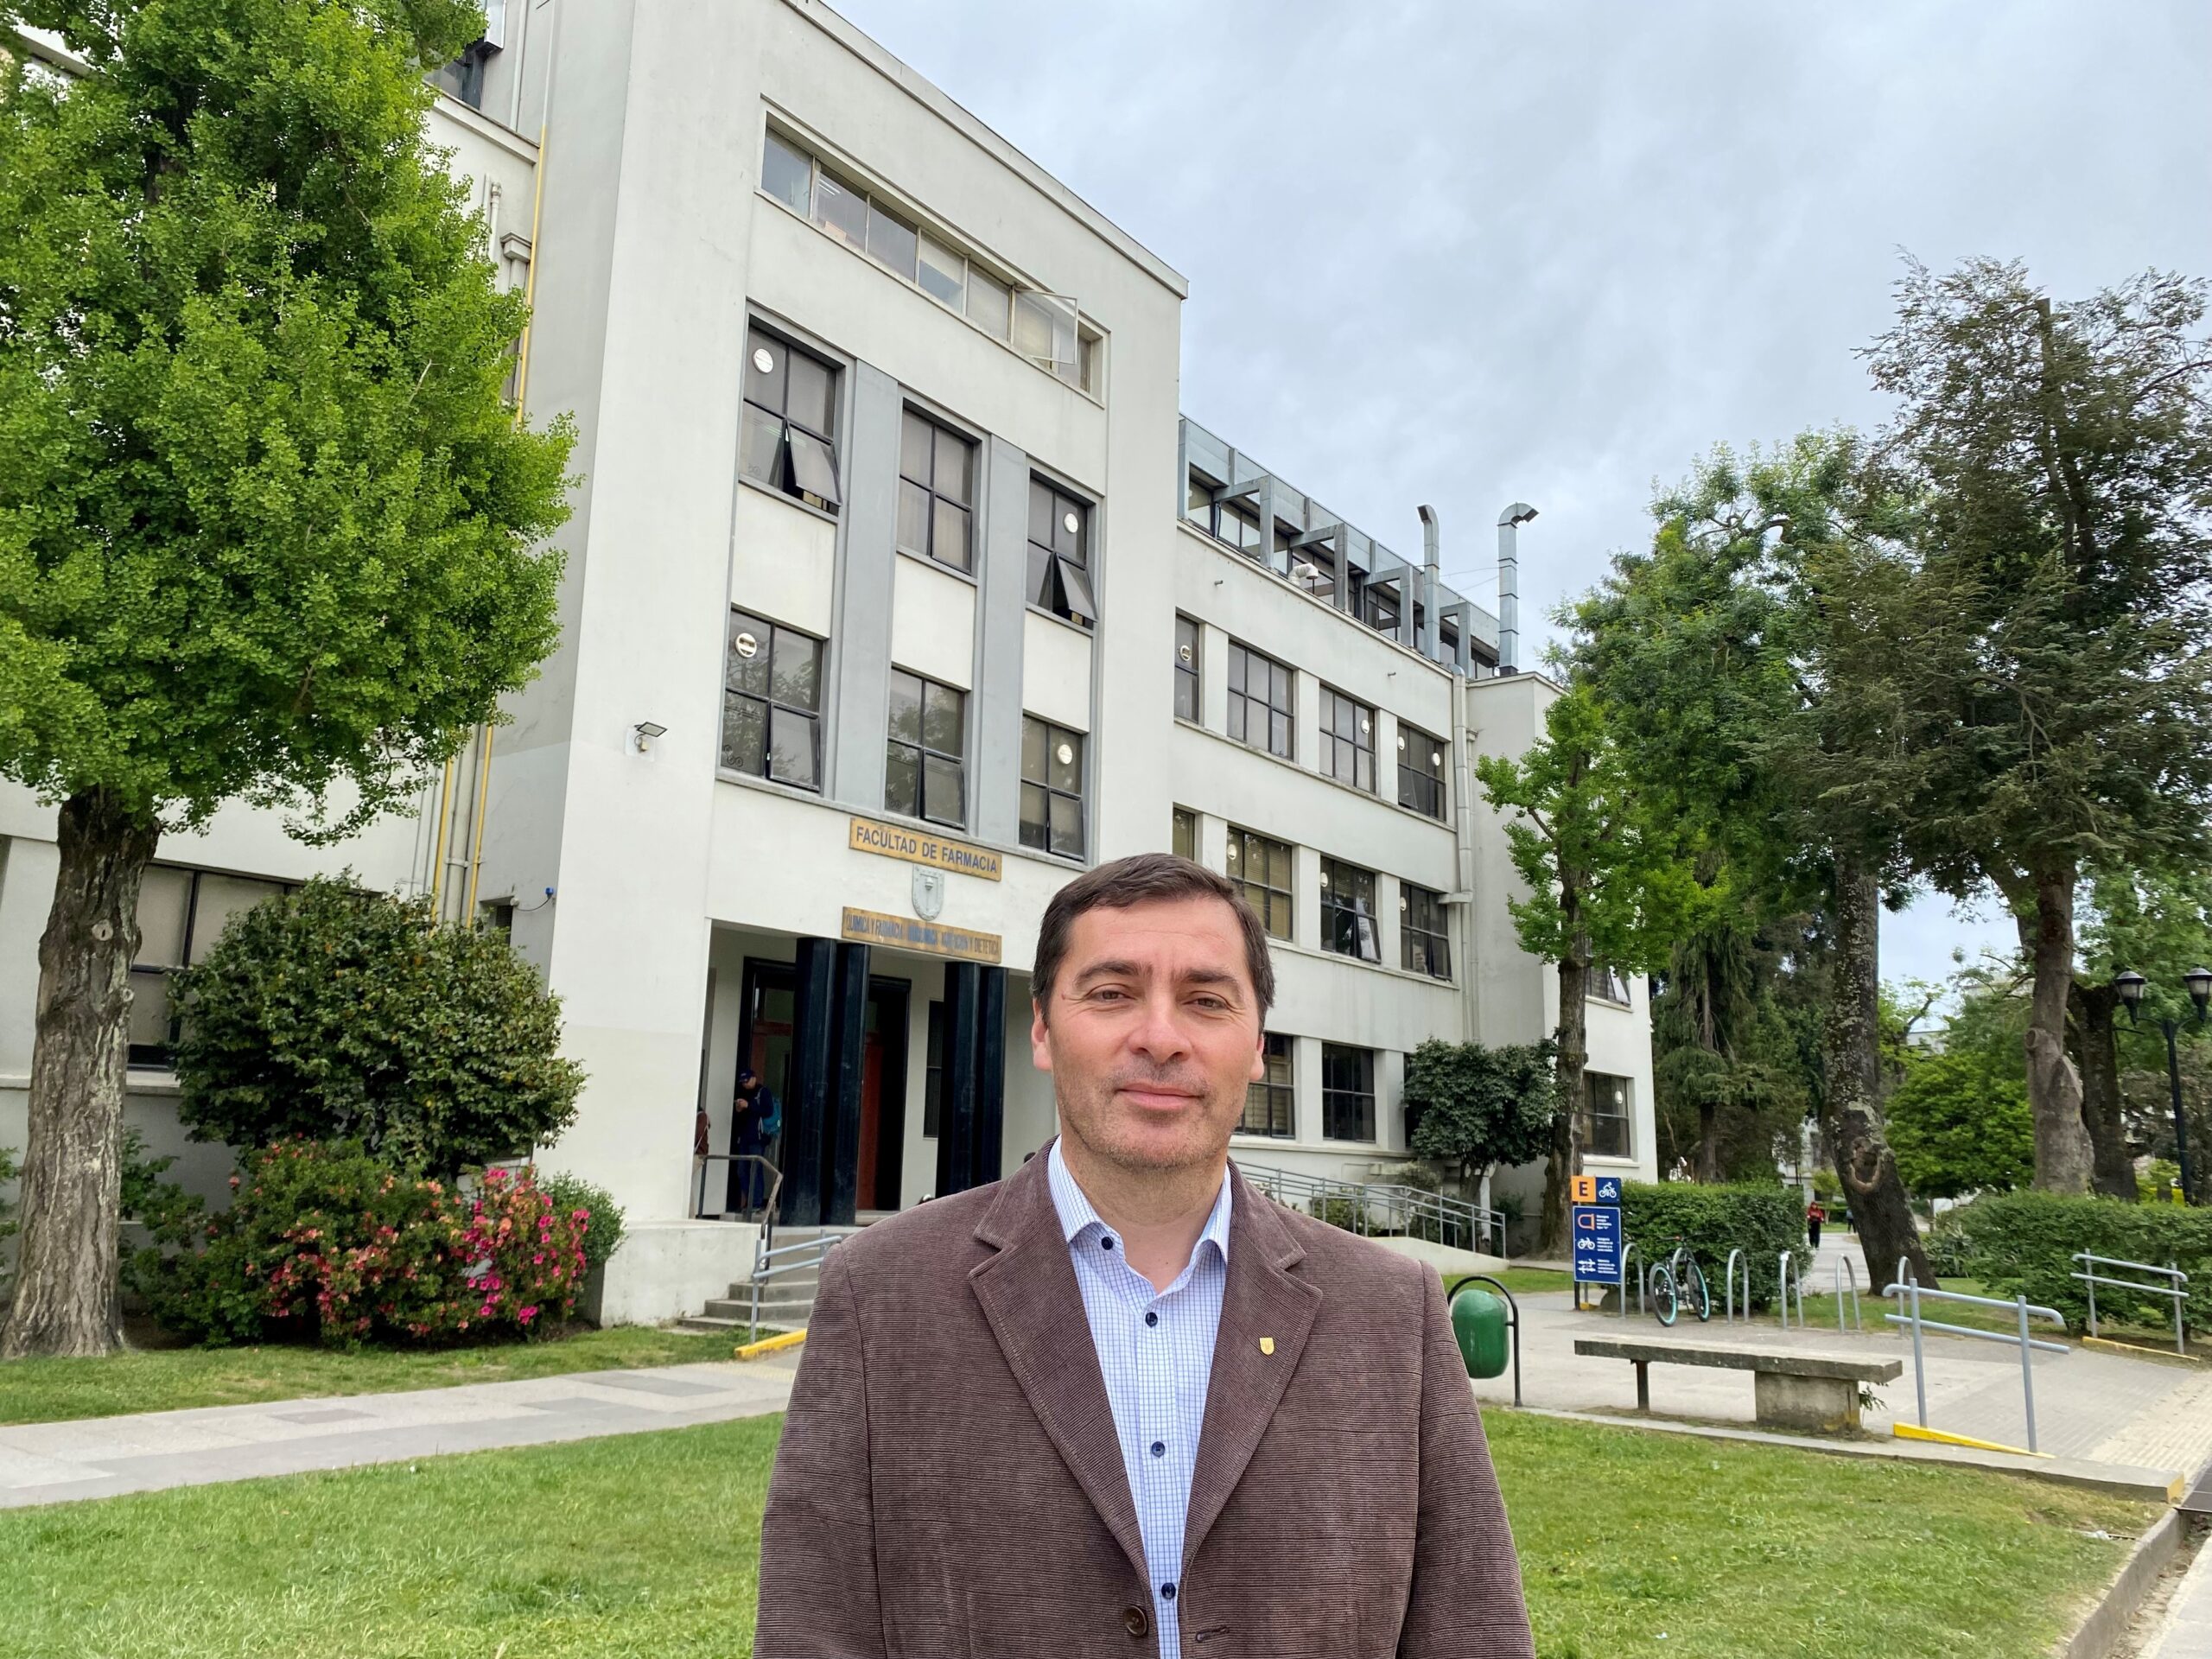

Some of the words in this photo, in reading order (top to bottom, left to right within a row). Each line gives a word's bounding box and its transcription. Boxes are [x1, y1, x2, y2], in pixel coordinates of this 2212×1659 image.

[856, 826, 917, 854] FACULTAD
[922, 842, 937, 860] DE
[942, 847, 997, 873] FARMACIA
[1579, 1181, 1588, 1197] E
